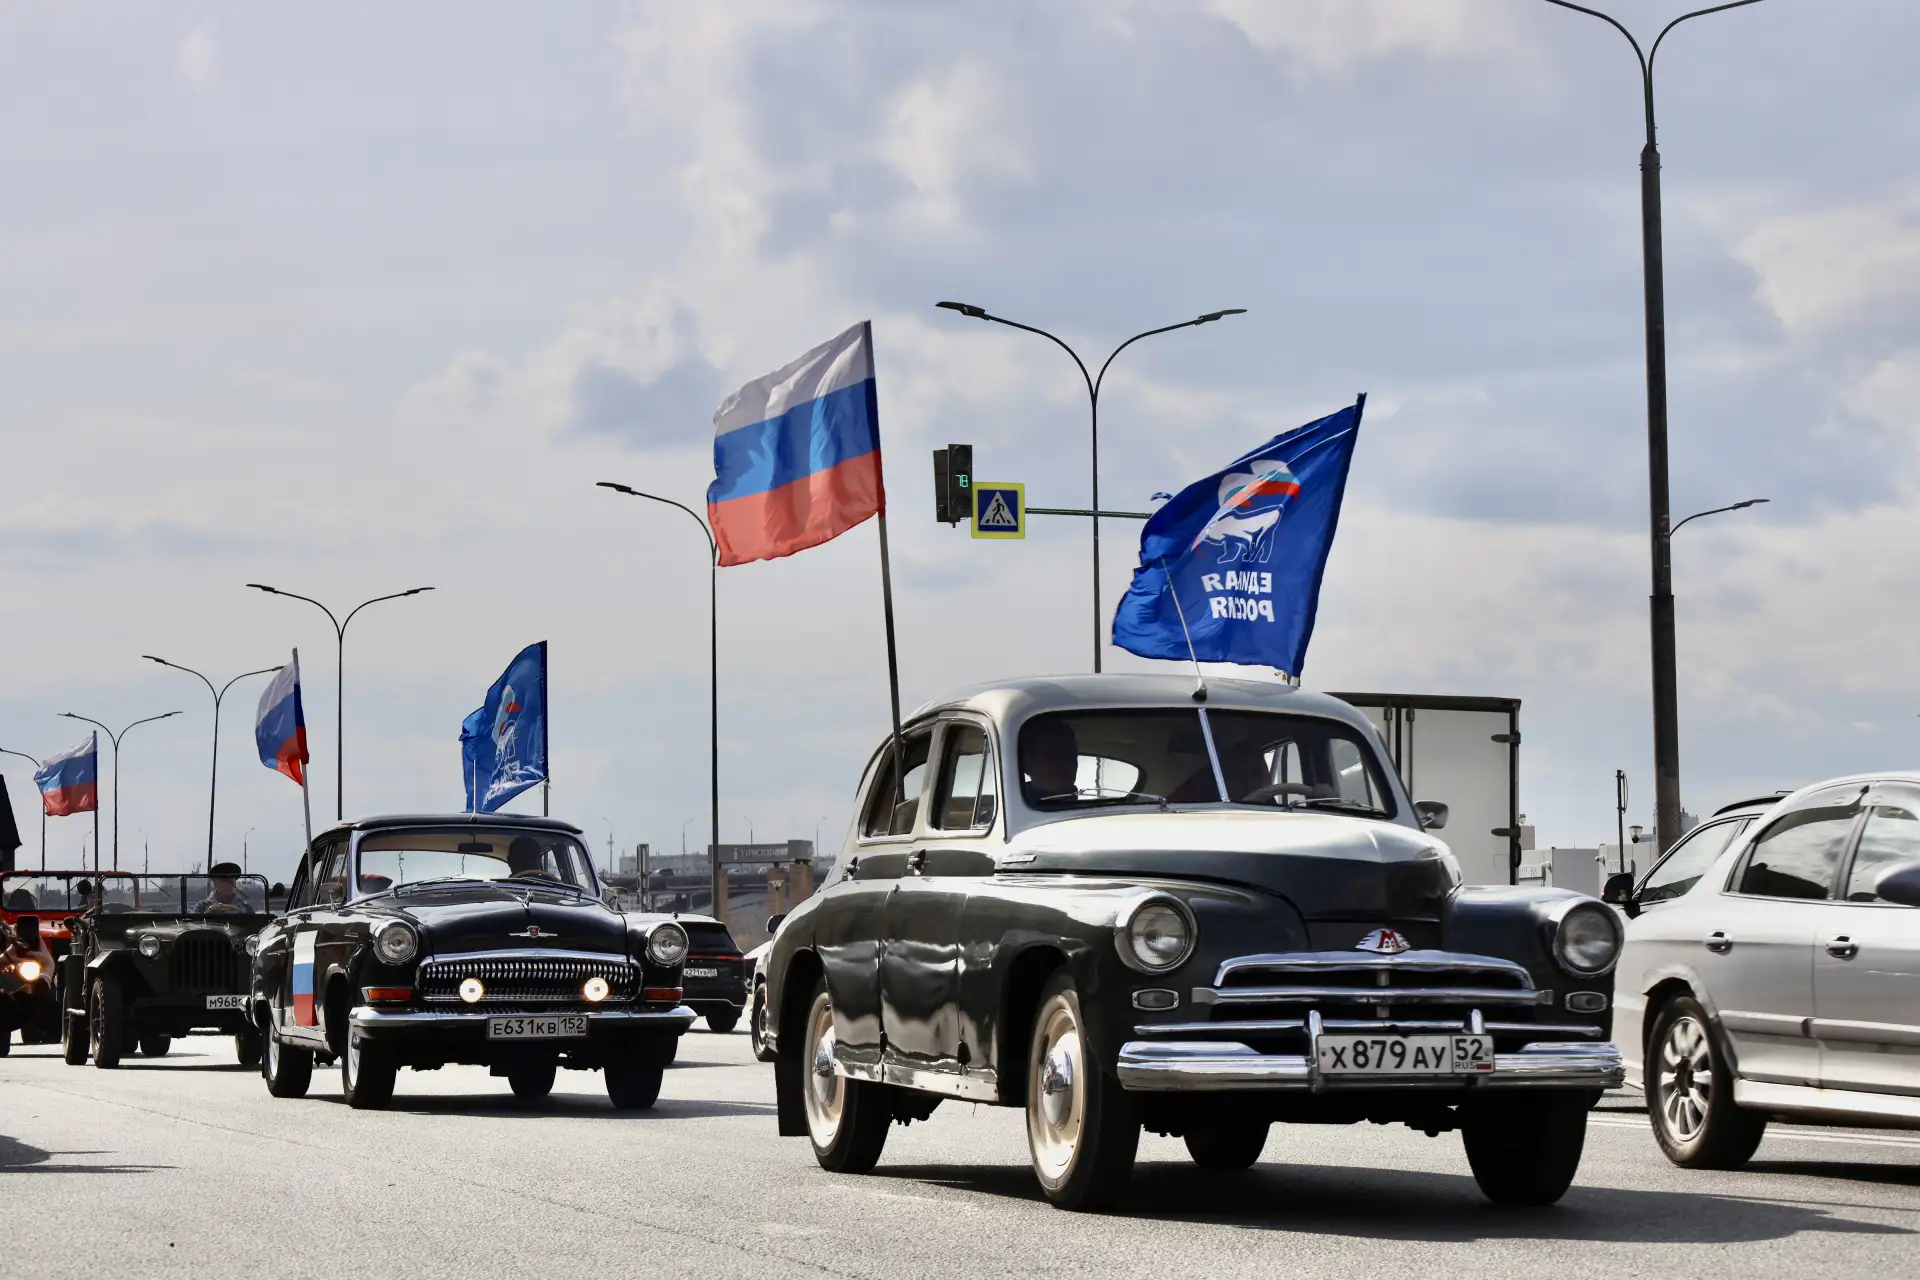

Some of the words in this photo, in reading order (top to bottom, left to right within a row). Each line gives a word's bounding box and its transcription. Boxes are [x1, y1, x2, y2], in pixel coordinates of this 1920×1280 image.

[493, 1019, 557, 1035] Е631КВ
[560, 1017, 584, 1029] 152
[1330, 1039, 1446, 1069] Х879АУ
[1455, 1039, 1483, 1061] 52
[1455, 1061, 1475, 1069] RUS
